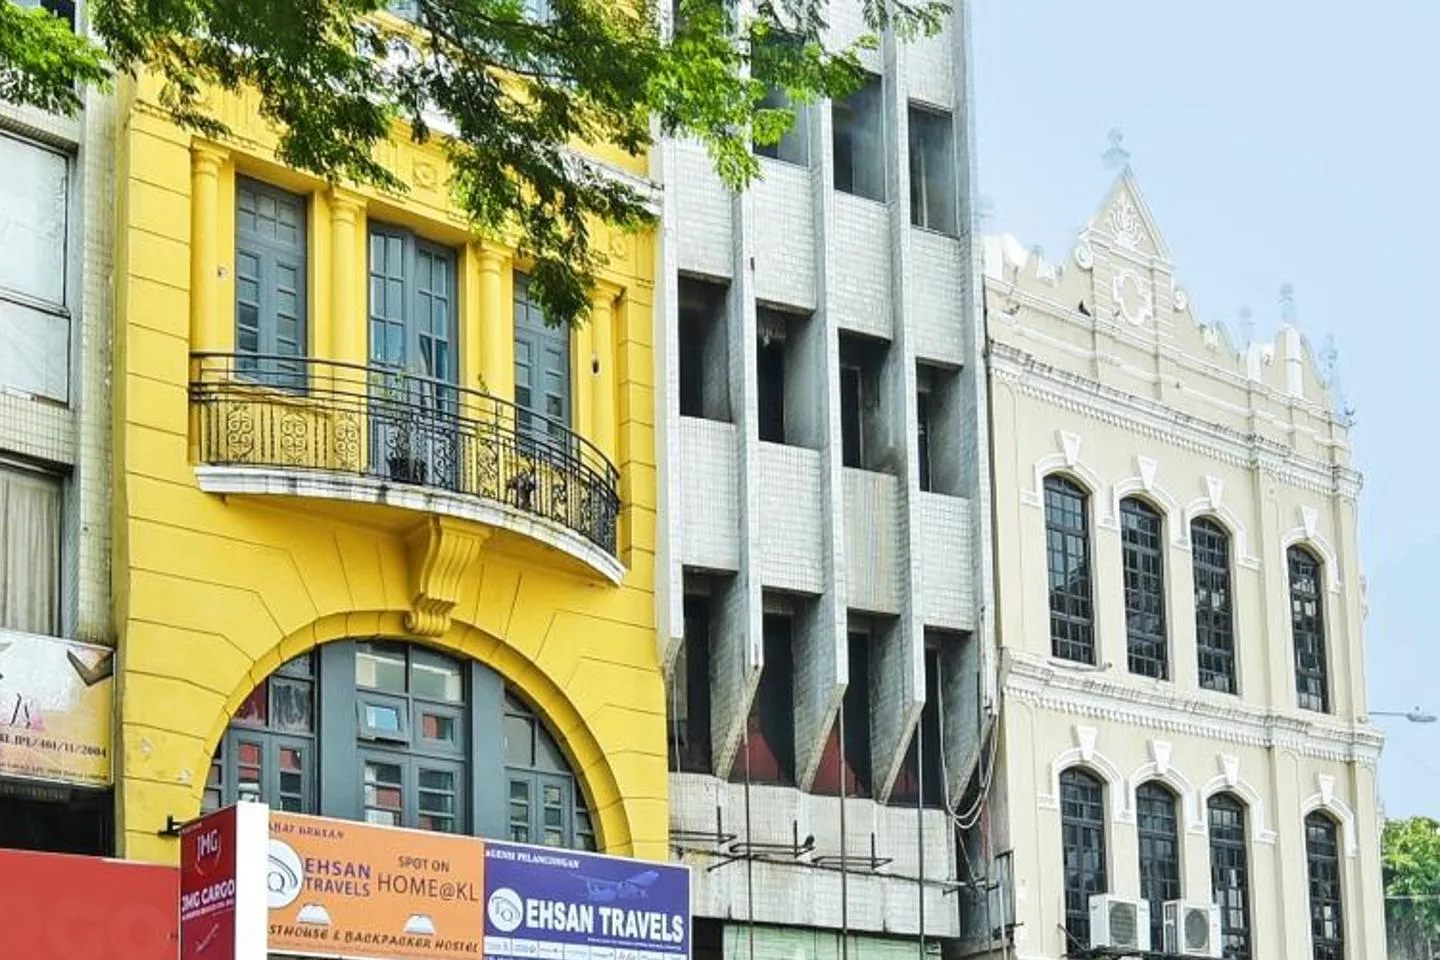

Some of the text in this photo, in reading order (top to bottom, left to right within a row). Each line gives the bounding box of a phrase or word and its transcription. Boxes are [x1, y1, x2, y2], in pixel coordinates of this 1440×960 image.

[305, 858, 371, 880] EHSAN
[398, 856, 450, 872] SPOT ON
[201, 879, 235, 906] CARGO
[305, 877, 370, 897] TRAVELS
[377, 874, 479, 902] HOME@KL
[269, 924, 328, 940] STHOUSE
[526, 898, 684, 944] EHSAN TRAVELS
